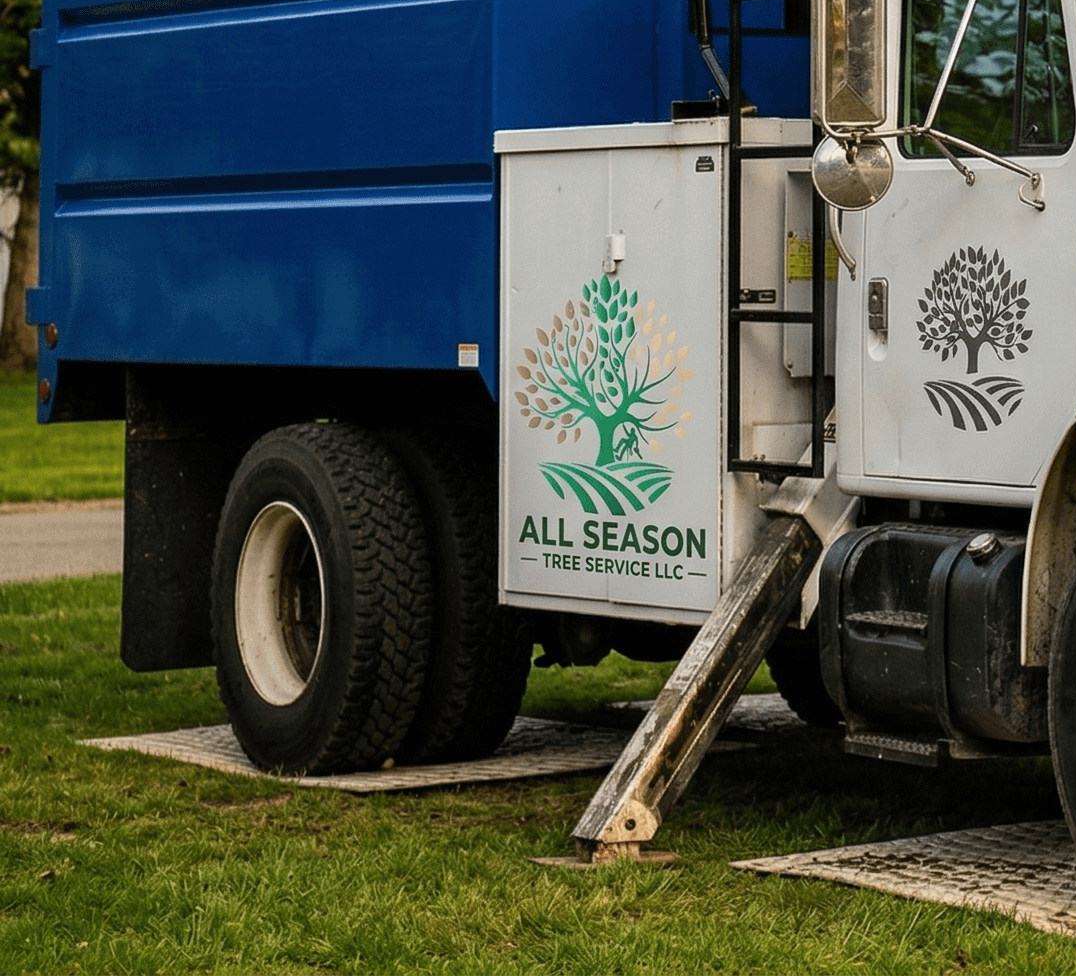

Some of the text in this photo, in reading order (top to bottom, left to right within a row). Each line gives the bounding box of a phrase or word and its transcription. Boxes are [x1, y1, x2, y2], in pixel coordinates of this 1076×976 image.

[518, 515, 706, 559] ALL SEASON
[542, 552, 683, 580] TREE SERVICE LLC
